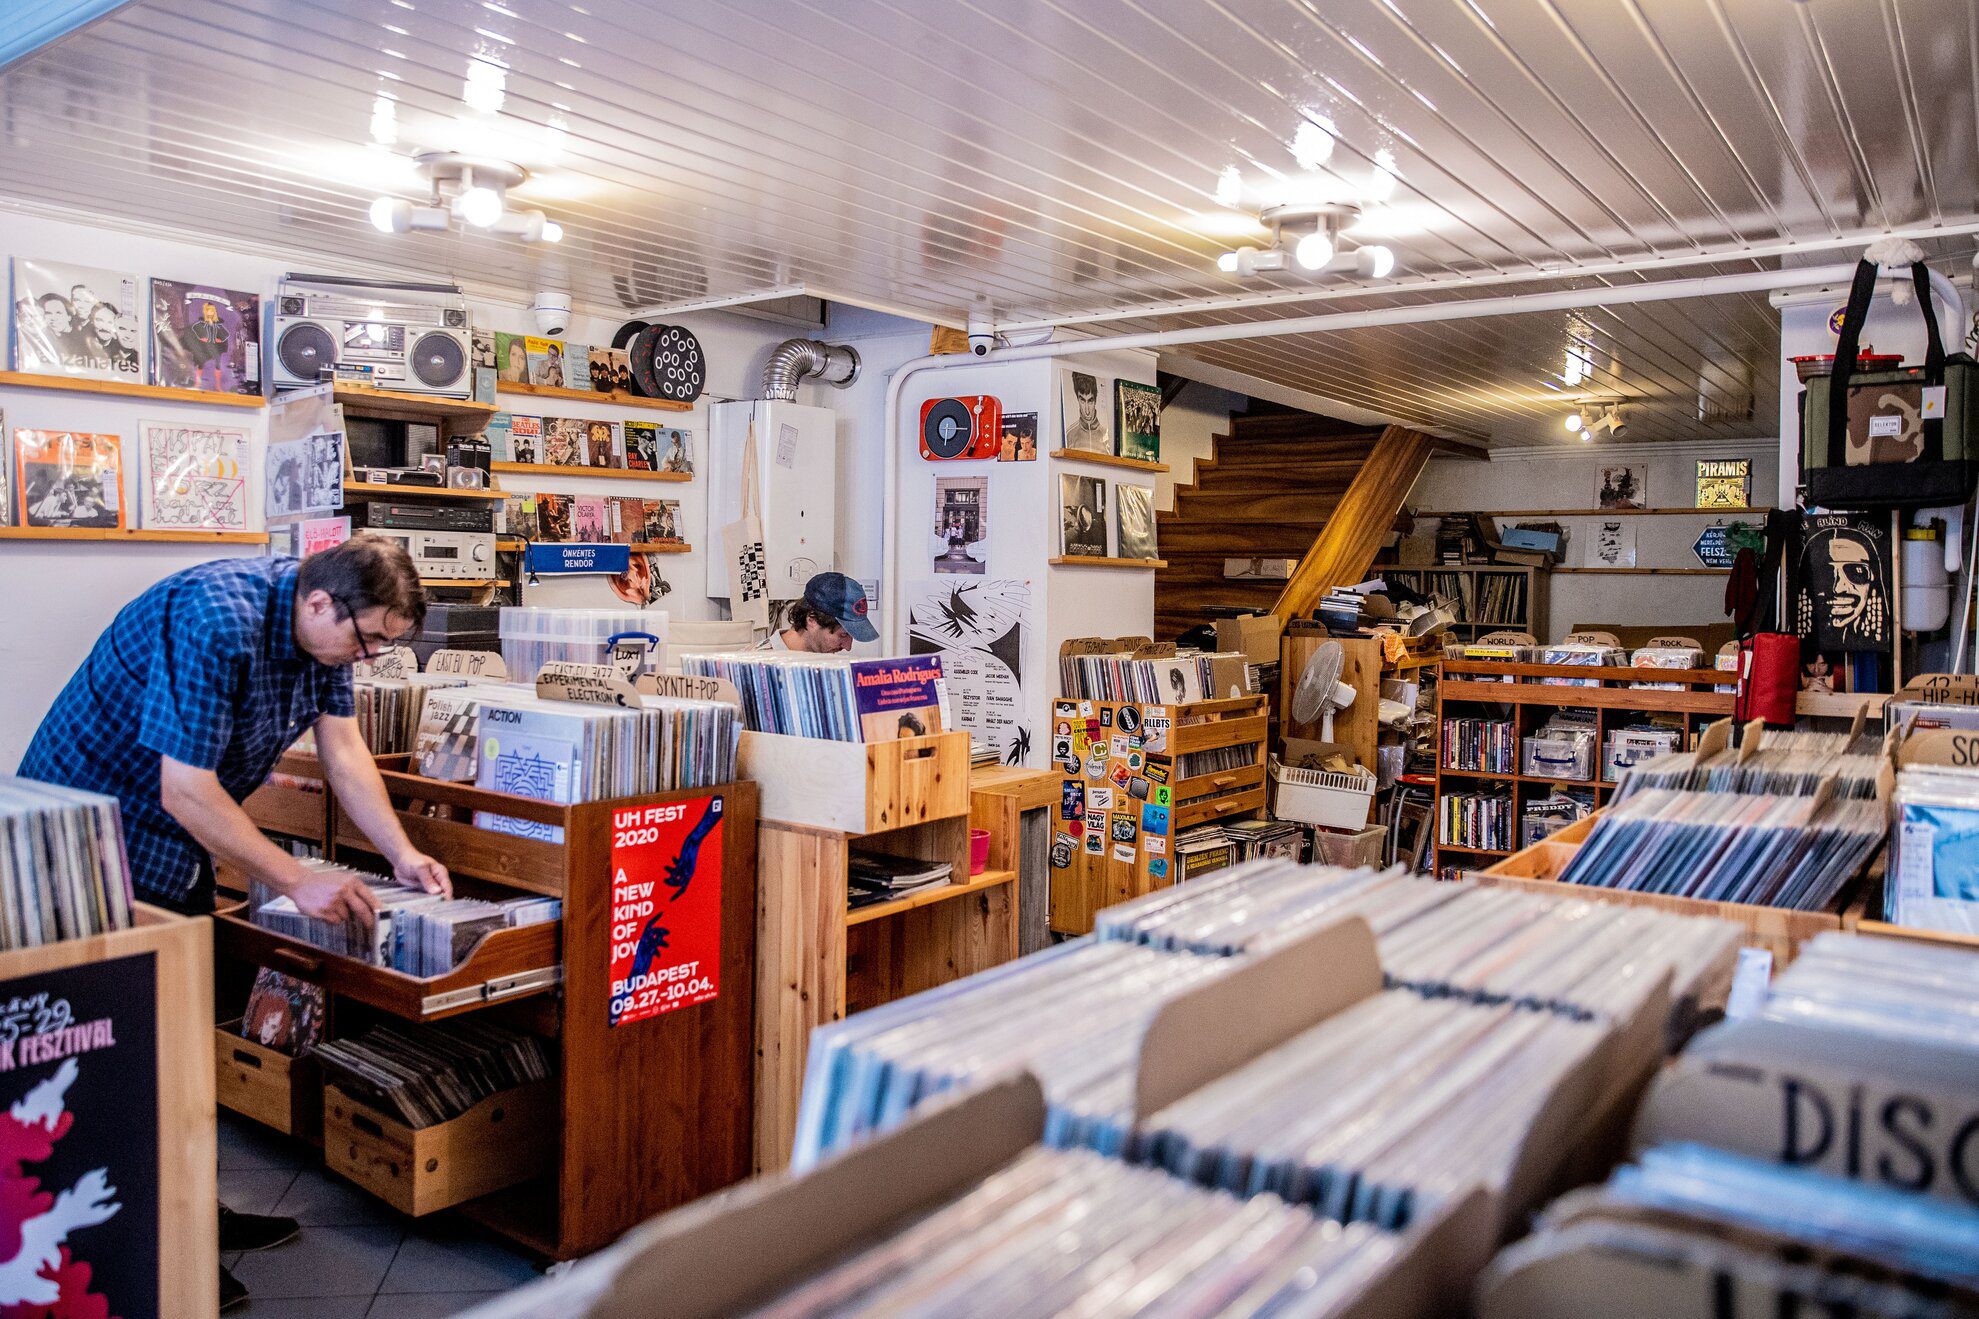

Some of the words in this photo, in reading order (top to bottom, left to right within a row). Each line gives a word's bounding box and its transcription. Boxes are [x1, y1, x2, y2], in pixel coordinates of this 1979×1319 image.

[512, 420, 540, 430] BEATLES
[628, 452, 638, 460] RAY
[628, 460, 650, 469] CHARLES
[1698, 461, 1748, 477] PIRAMIS
[1858, 520, 1884, 539] MAN
[562, 547, 596, 558] ÖNKÉNTES
[1487, 638, 1516, 646] WORLD
[436, 652, 452, 672] EAST
[467, 654, 486, 676] POP
[857, 669, 892, 688] Amalia
[892, 666, 942, 685] Rodrigues
[656, 676, 720, 700] SYNTH-POP
[428, 698, 452, 713] Polish
[488, 710, 522, 725] ACTION
[1144, 718, 1170, 728] RLLBTS
[614, 811, 641, 830] UH
[645, 804, 687, 824] FEST
[1088, 814, 1104, 822] NAGY
[614, 827, 659, 849] 2020
[614, 868, 628, 885] A
[614, 881, 655, 904] NEW
[614, 900, 654, 923] KIND
[612, 922, 638, 942] OF
[611, 939, 642, 965] JOY
[612, 961, 700, 998] BUDAPEST
[610, 976, 715, 1016] 09.27.-10.04.
